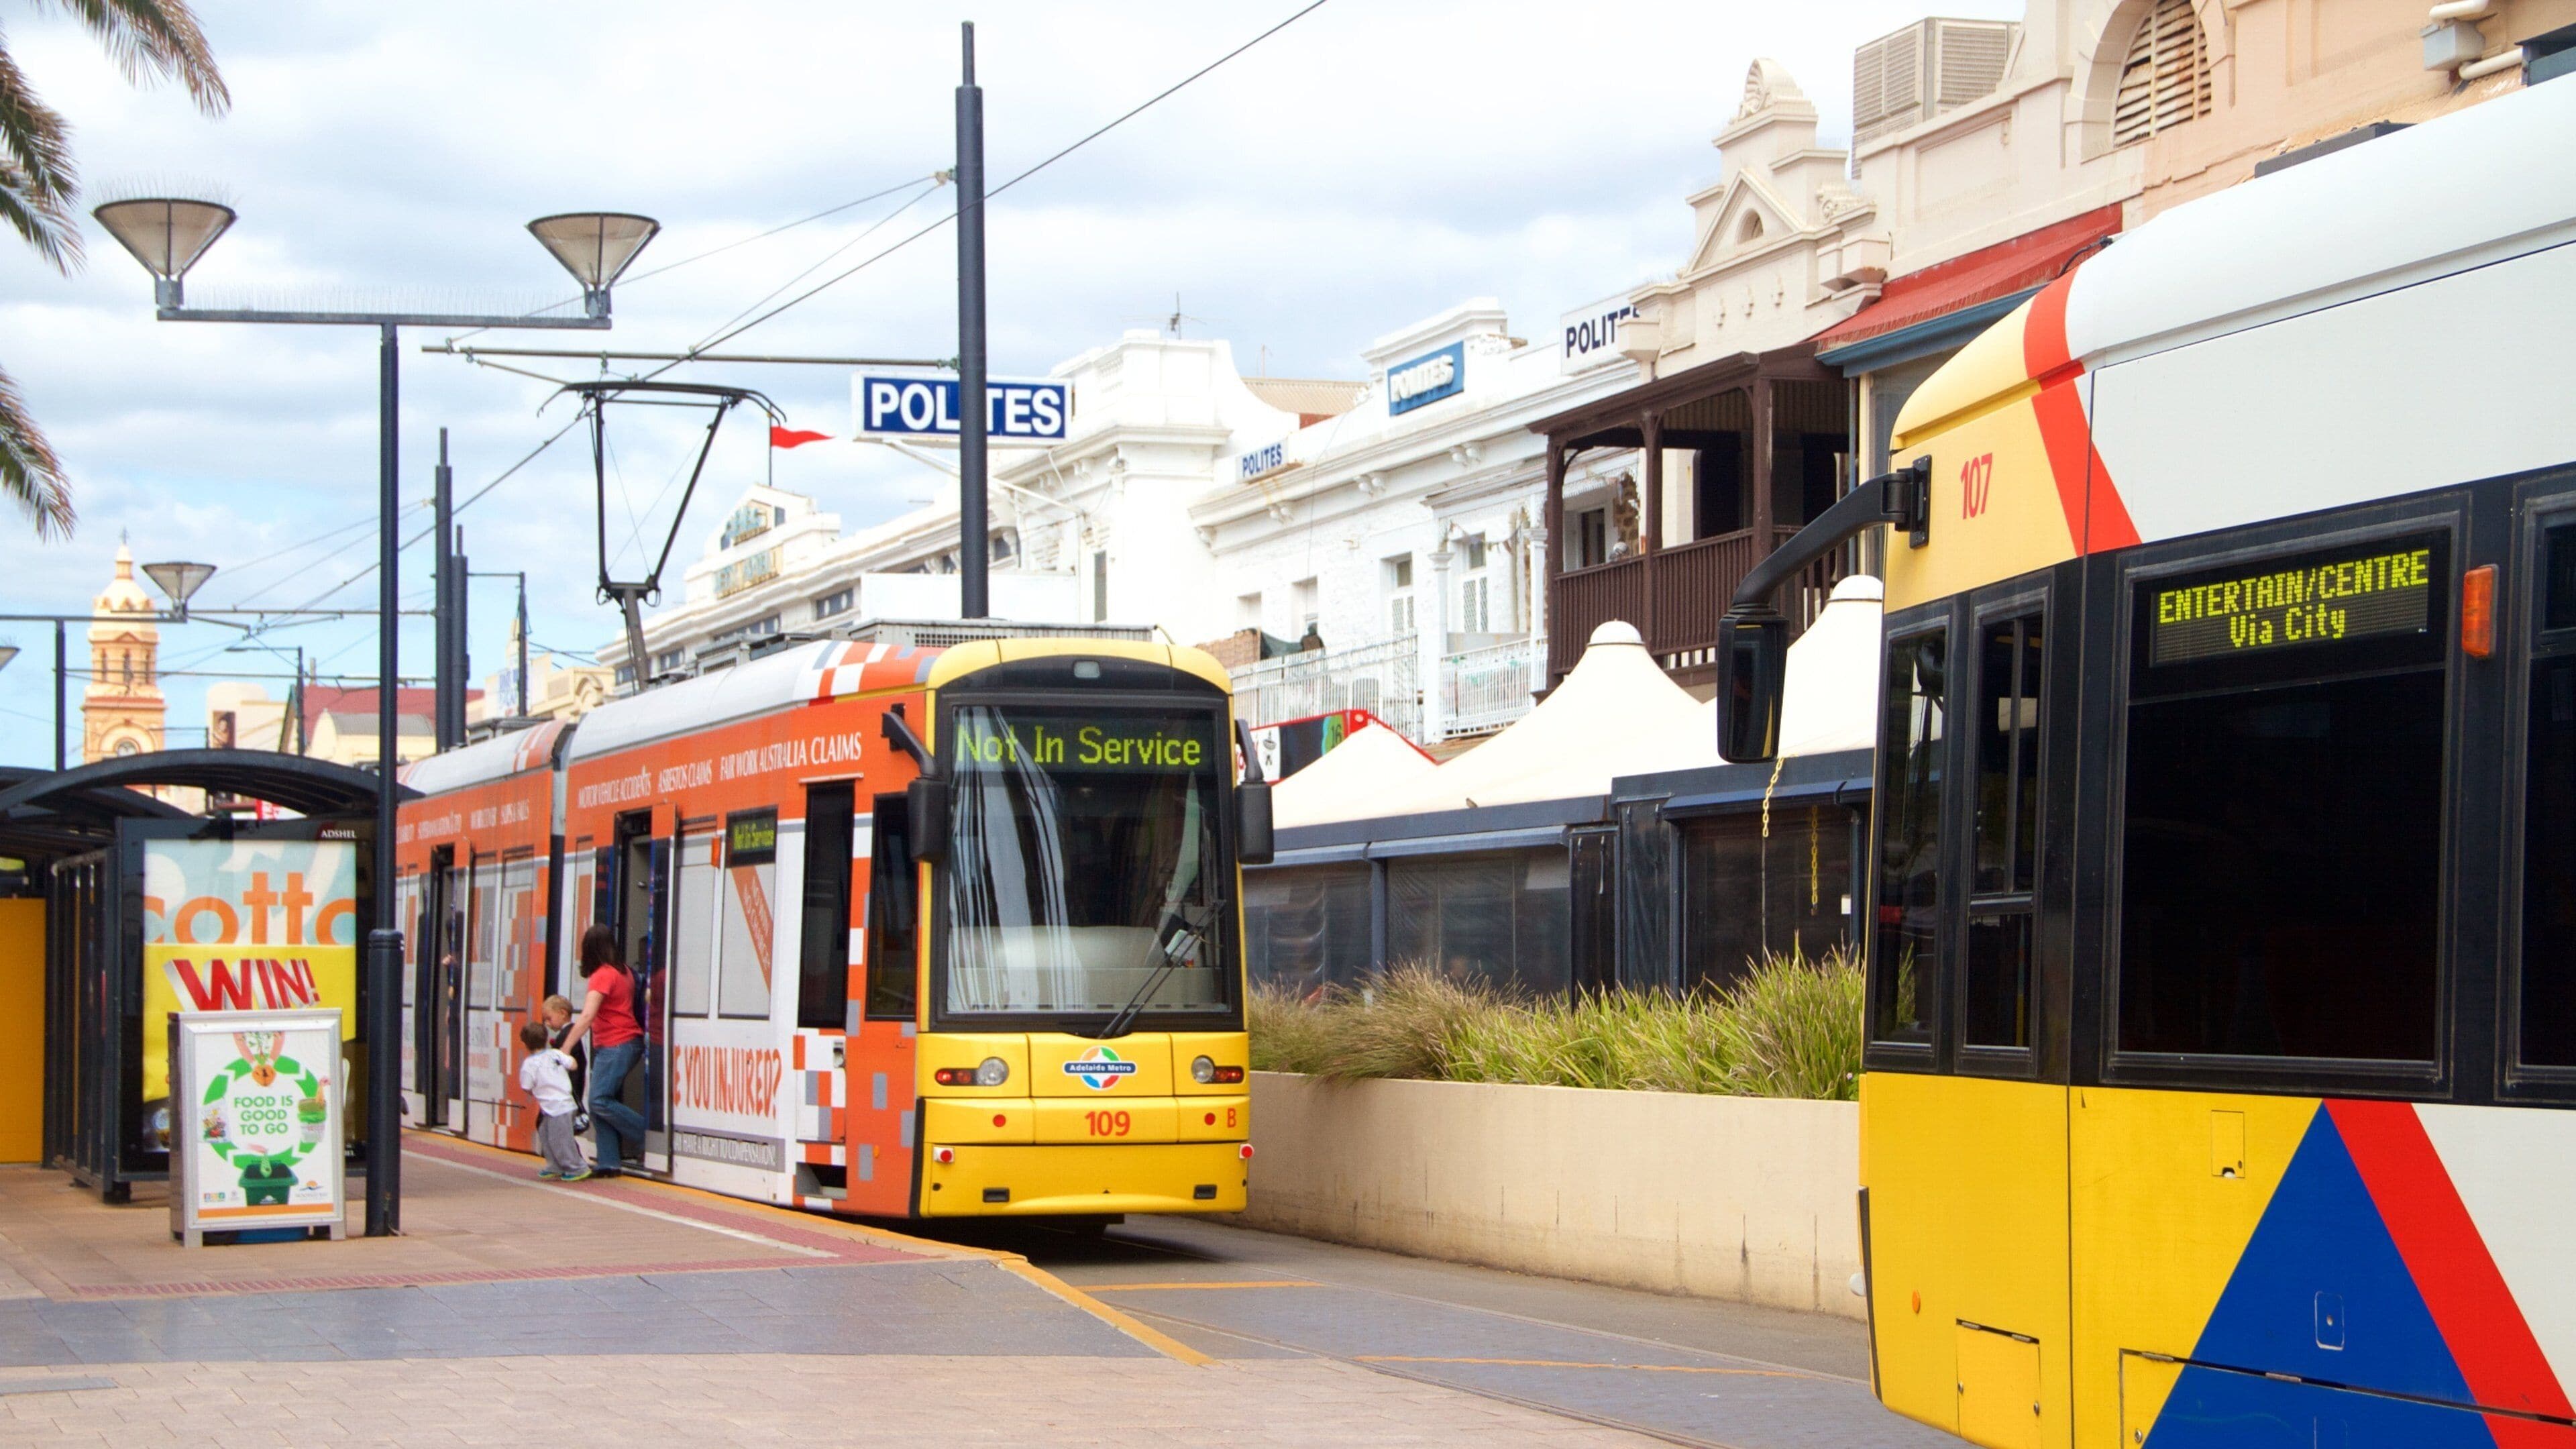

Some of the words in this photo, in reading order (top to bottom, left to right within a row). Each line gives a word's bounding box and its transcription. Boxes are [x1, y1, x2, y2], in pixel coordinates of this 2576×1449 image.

[1566, 307, 1640, 358] POLIT
[1390, 355, 1454, 402] POLITES
[871, 382, 1062, 435] POLTES
[1242, 443, 1282, 478] POLITES
[1960, 452, 1992, 520] 107
[2159, 549, 2430, 625] ENTERTAIN/CENTRE
[2230, 613, 2273, 648] Via
[2286, 603, 2346, 641] City
[720, 753, 735, 781] FAIR
[736, 747, 759, 777] WORK
[759, 739, 808, 773] AUSTRALIA
[810, 731, 862, 765] CLAIMS
[957, 724, 1018, 763] Not
[1034, 725, 1064, 763] In
[1079, 726, 1201, 765] Service
[658, 765, 688, 794] ASBESTOS
[321, 829, 357, 839] ADSHEL
[168, 959, 321, 1011] WIN!
[684, 1044, 710, 1112] YOU
[714, 1046, 782, 1121] INJURED?
[1069, 1064, 1106, 1072] Adelaide
[1107, 1064, 1132, 1072] Metro
[234, 1095, 276, 1108] FOOD
[281, 1095, 293, 1107] IS
[240, 1109, 288, 1122] GOOD
[1227, 1108, 1237, 1128] B
[239, 1124, 260, 1135] TO
[264, 1122, 288, 1134] GO
[1085, 1110, 1131, 1136] 109
